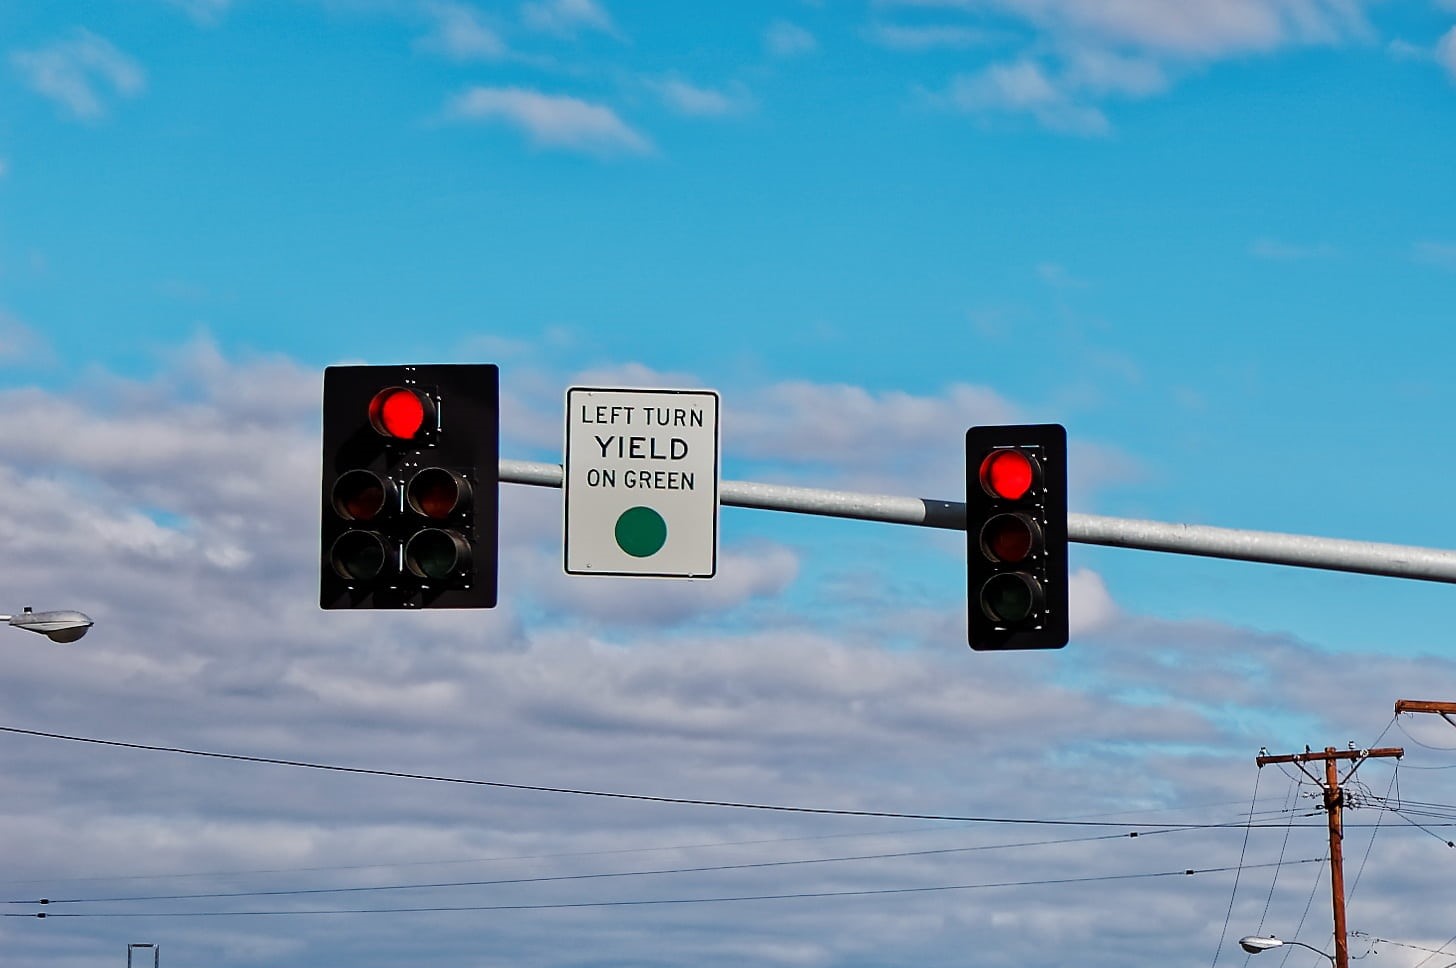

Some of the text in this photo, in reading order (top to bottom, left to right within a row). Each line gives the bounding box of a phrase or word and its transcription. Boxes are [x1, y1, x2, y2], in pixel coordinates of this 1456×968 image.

[581, 405, 703, 428] LEFT TURN
[595, 435, 689, 460] YIELD
[586, 469, 695, 491] ON GREEN
